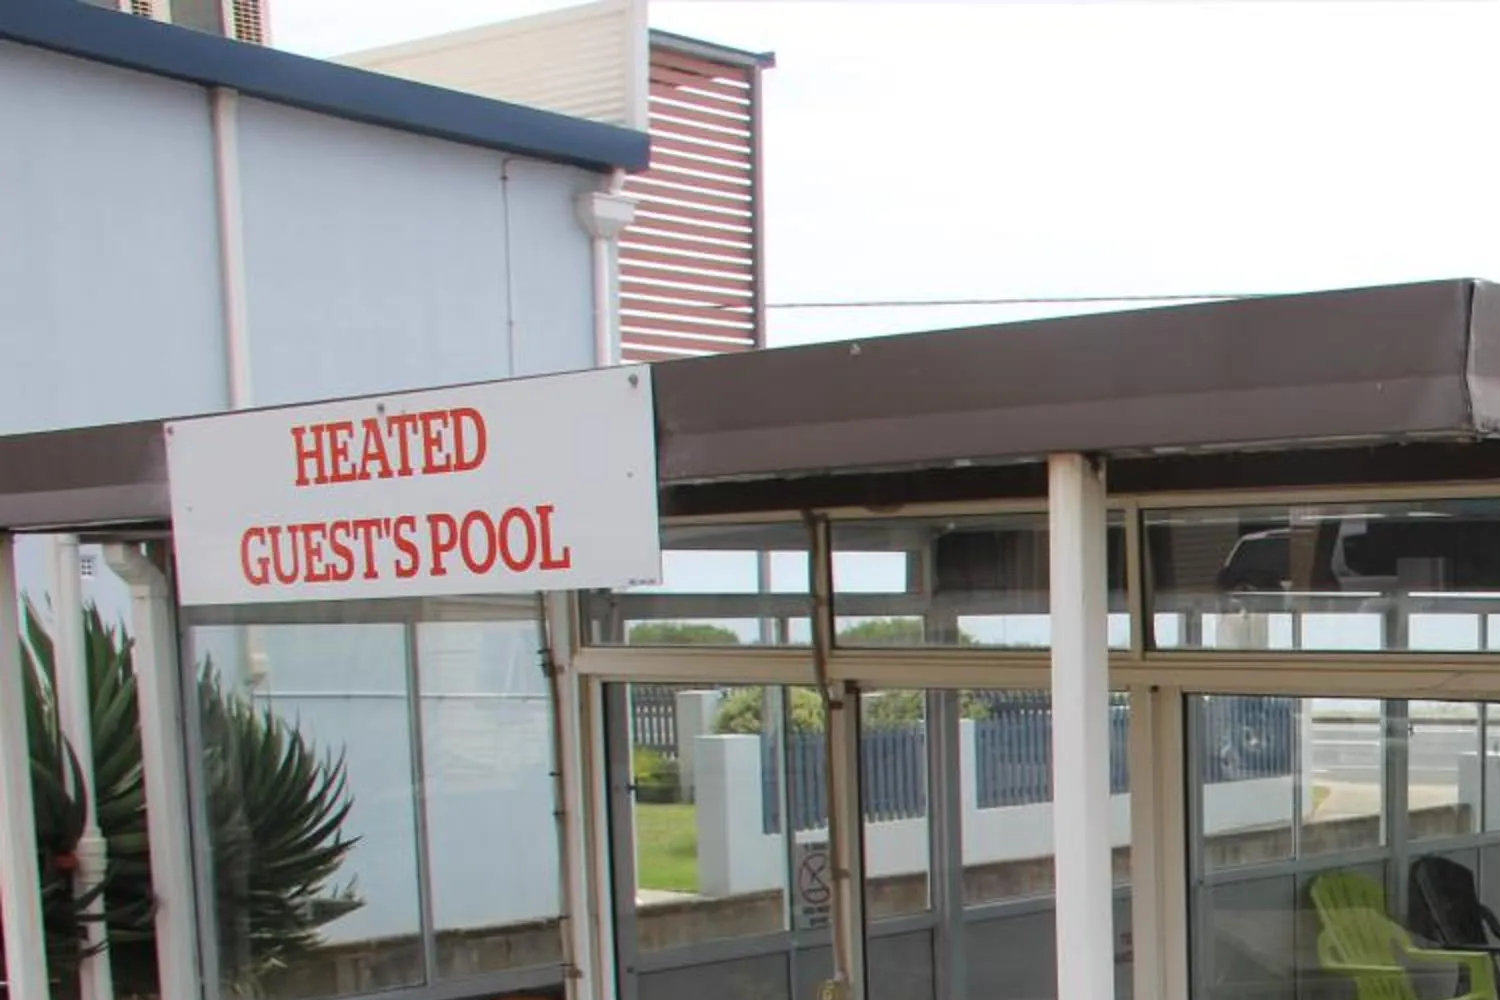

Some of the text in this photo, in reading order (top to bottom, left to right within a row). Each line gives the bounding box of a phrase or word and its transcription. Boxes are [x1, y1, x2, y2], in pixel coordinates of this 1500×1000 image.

[291, 407, 487, 487] HEATED
[240, 504, 571, 586] GUEST'S POOL
